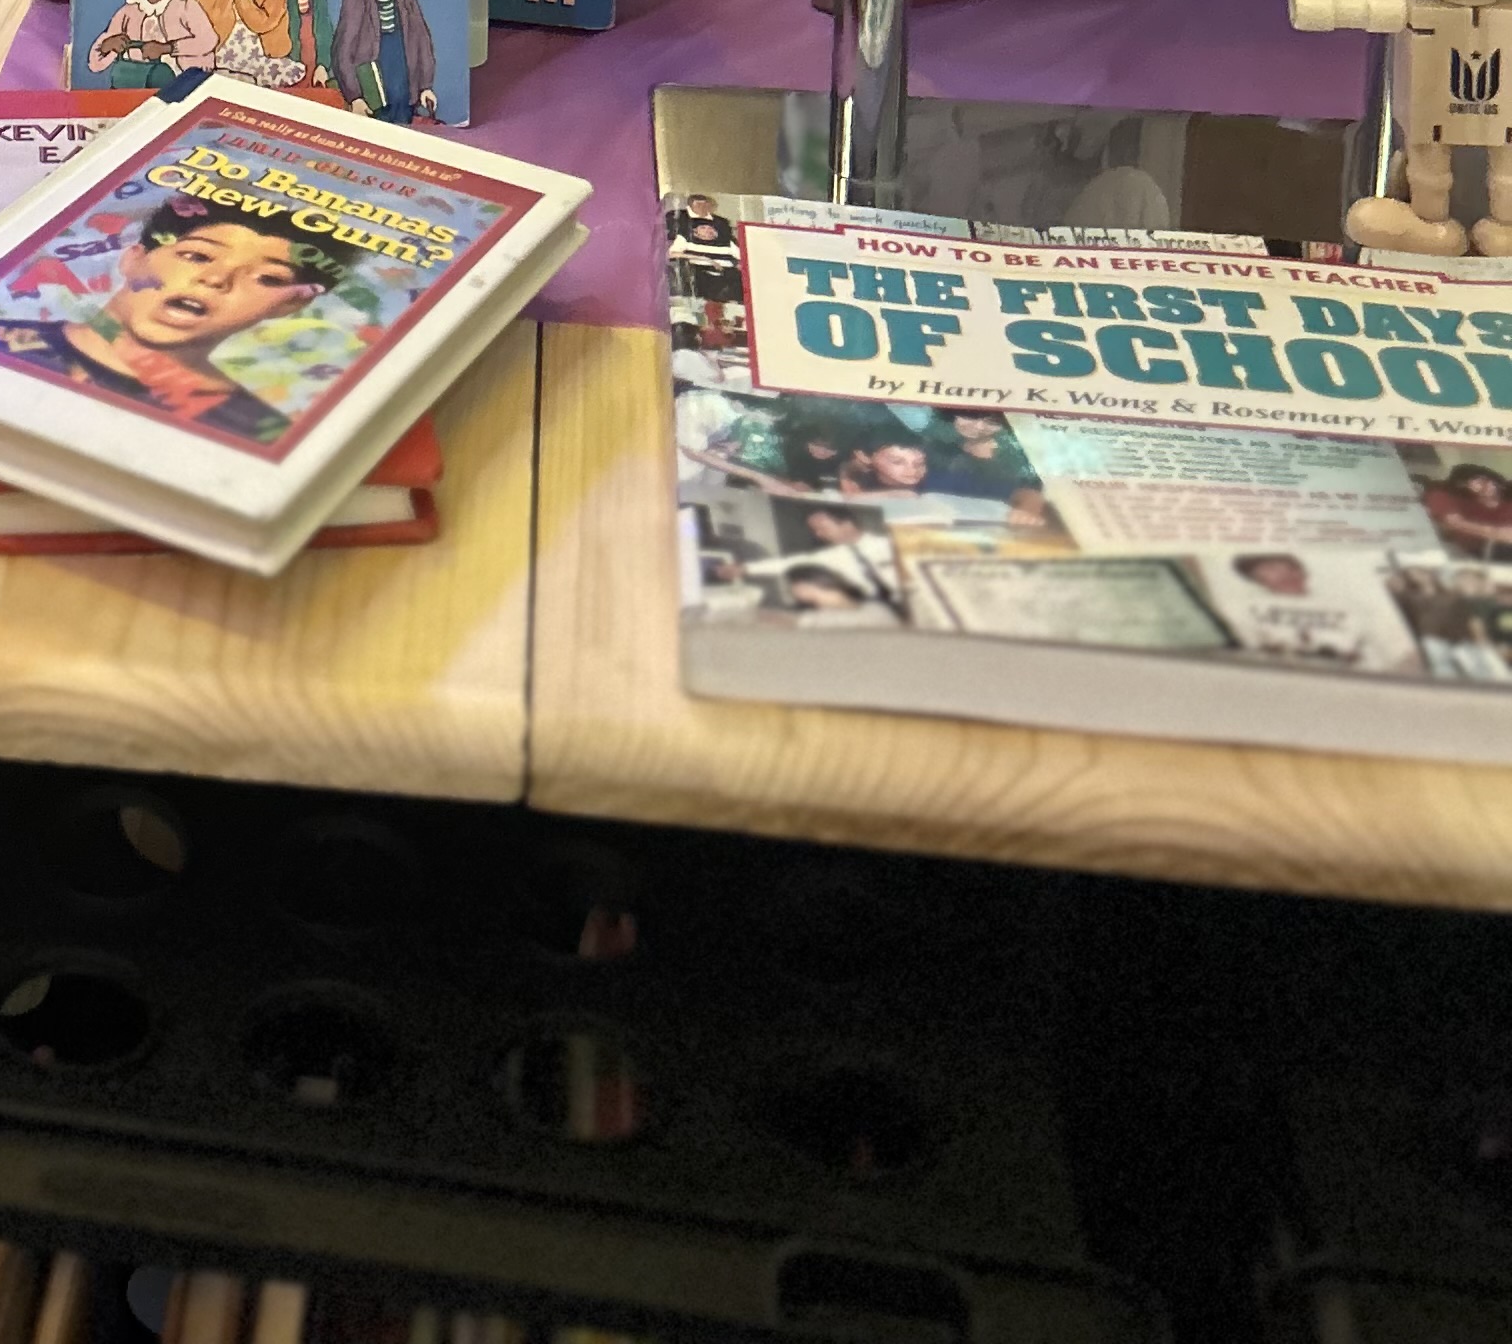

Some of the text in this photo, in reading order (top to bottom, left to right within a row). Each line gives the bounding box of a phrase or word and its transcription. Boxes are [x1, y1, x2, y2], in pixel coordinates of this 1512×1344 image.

[146, 164, 288, 218] Chew
[291, 205, 455, 269] Gum?
[176, 144, 460, 244] Do Bananas
[786, 256, 1512, 351] THE FIRST DAYS
[857, 237, 1439, 296] HOW TO BE AN EFFECTIVE TEACHER
[795, 300, 963, 368] OF
[868, 375, 904, 395] by
[917, 379, 1013, 404] Harry
[1025, 387, 1058, 405] K.
[1067, 389, 1161, 414] Wong
[1170, 398, 1199, 414] &
[1212, 401, 1376, 431] Rosemary
[1388, 415, 1420, 432] T.
